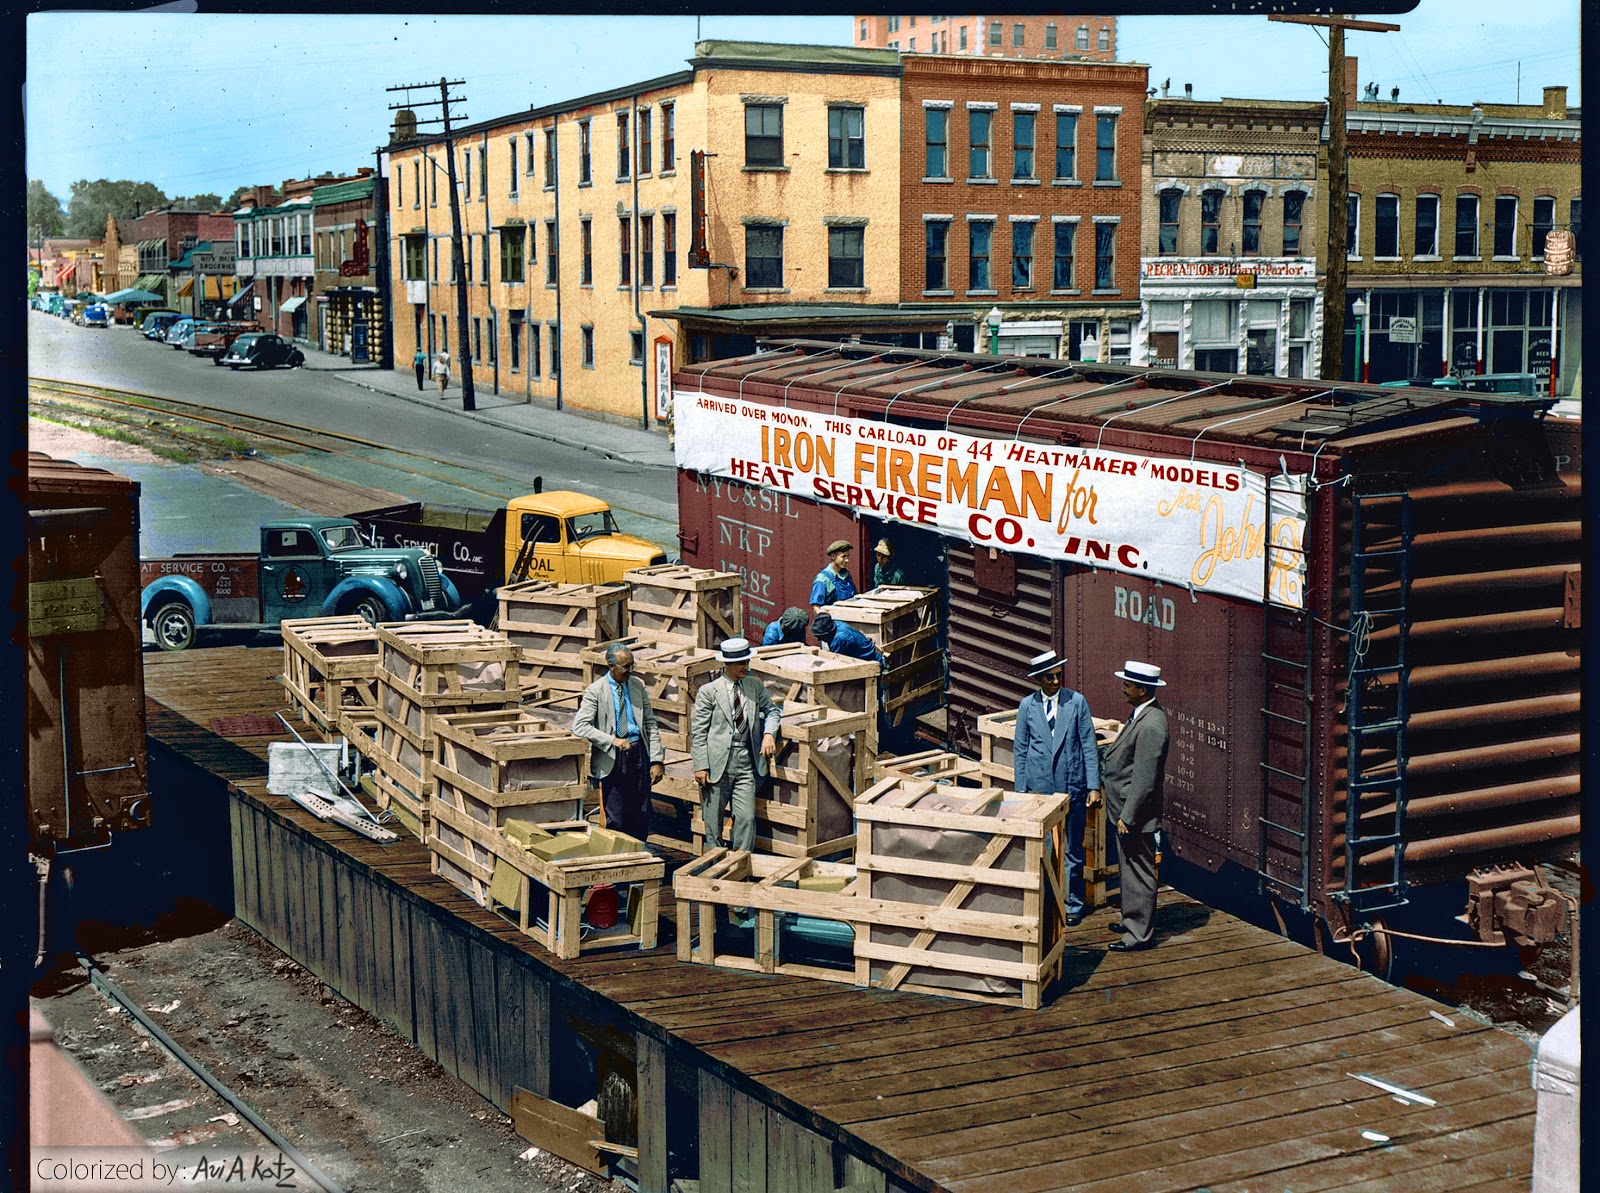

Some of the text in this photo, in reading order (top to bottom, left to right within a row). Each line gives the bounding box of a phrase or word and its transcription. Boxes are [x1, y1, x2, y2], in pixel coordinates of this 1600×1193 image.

[1147, 263, 1214, 276] RECREATION
[1532, 366, 1551, 376] LUNC
[696, 397, 738, 416] ARRIVED
[741, 406, 768, 422] OVER
[771, 411, 812, 428] MONON.
[824, 419, 852, 436] THIS
[858, 426, 927, 448] CARLOAD
[937, 436, 958, 451] OF
[967, 440, 993, 462] 44
[1150, 463, 1240, 492] MODELS
[760, 425, 1098, 536] IRON FIREMAN for
[730, 457, 1149, 571] HEAT SERVICE CO. INC.
[719, 522, 772, 558] NKP
[160, 562, 204, 573] SERVICE
[211, 562, 227, 573] CO.
[1113, 586, 1177, 632] ROAD
